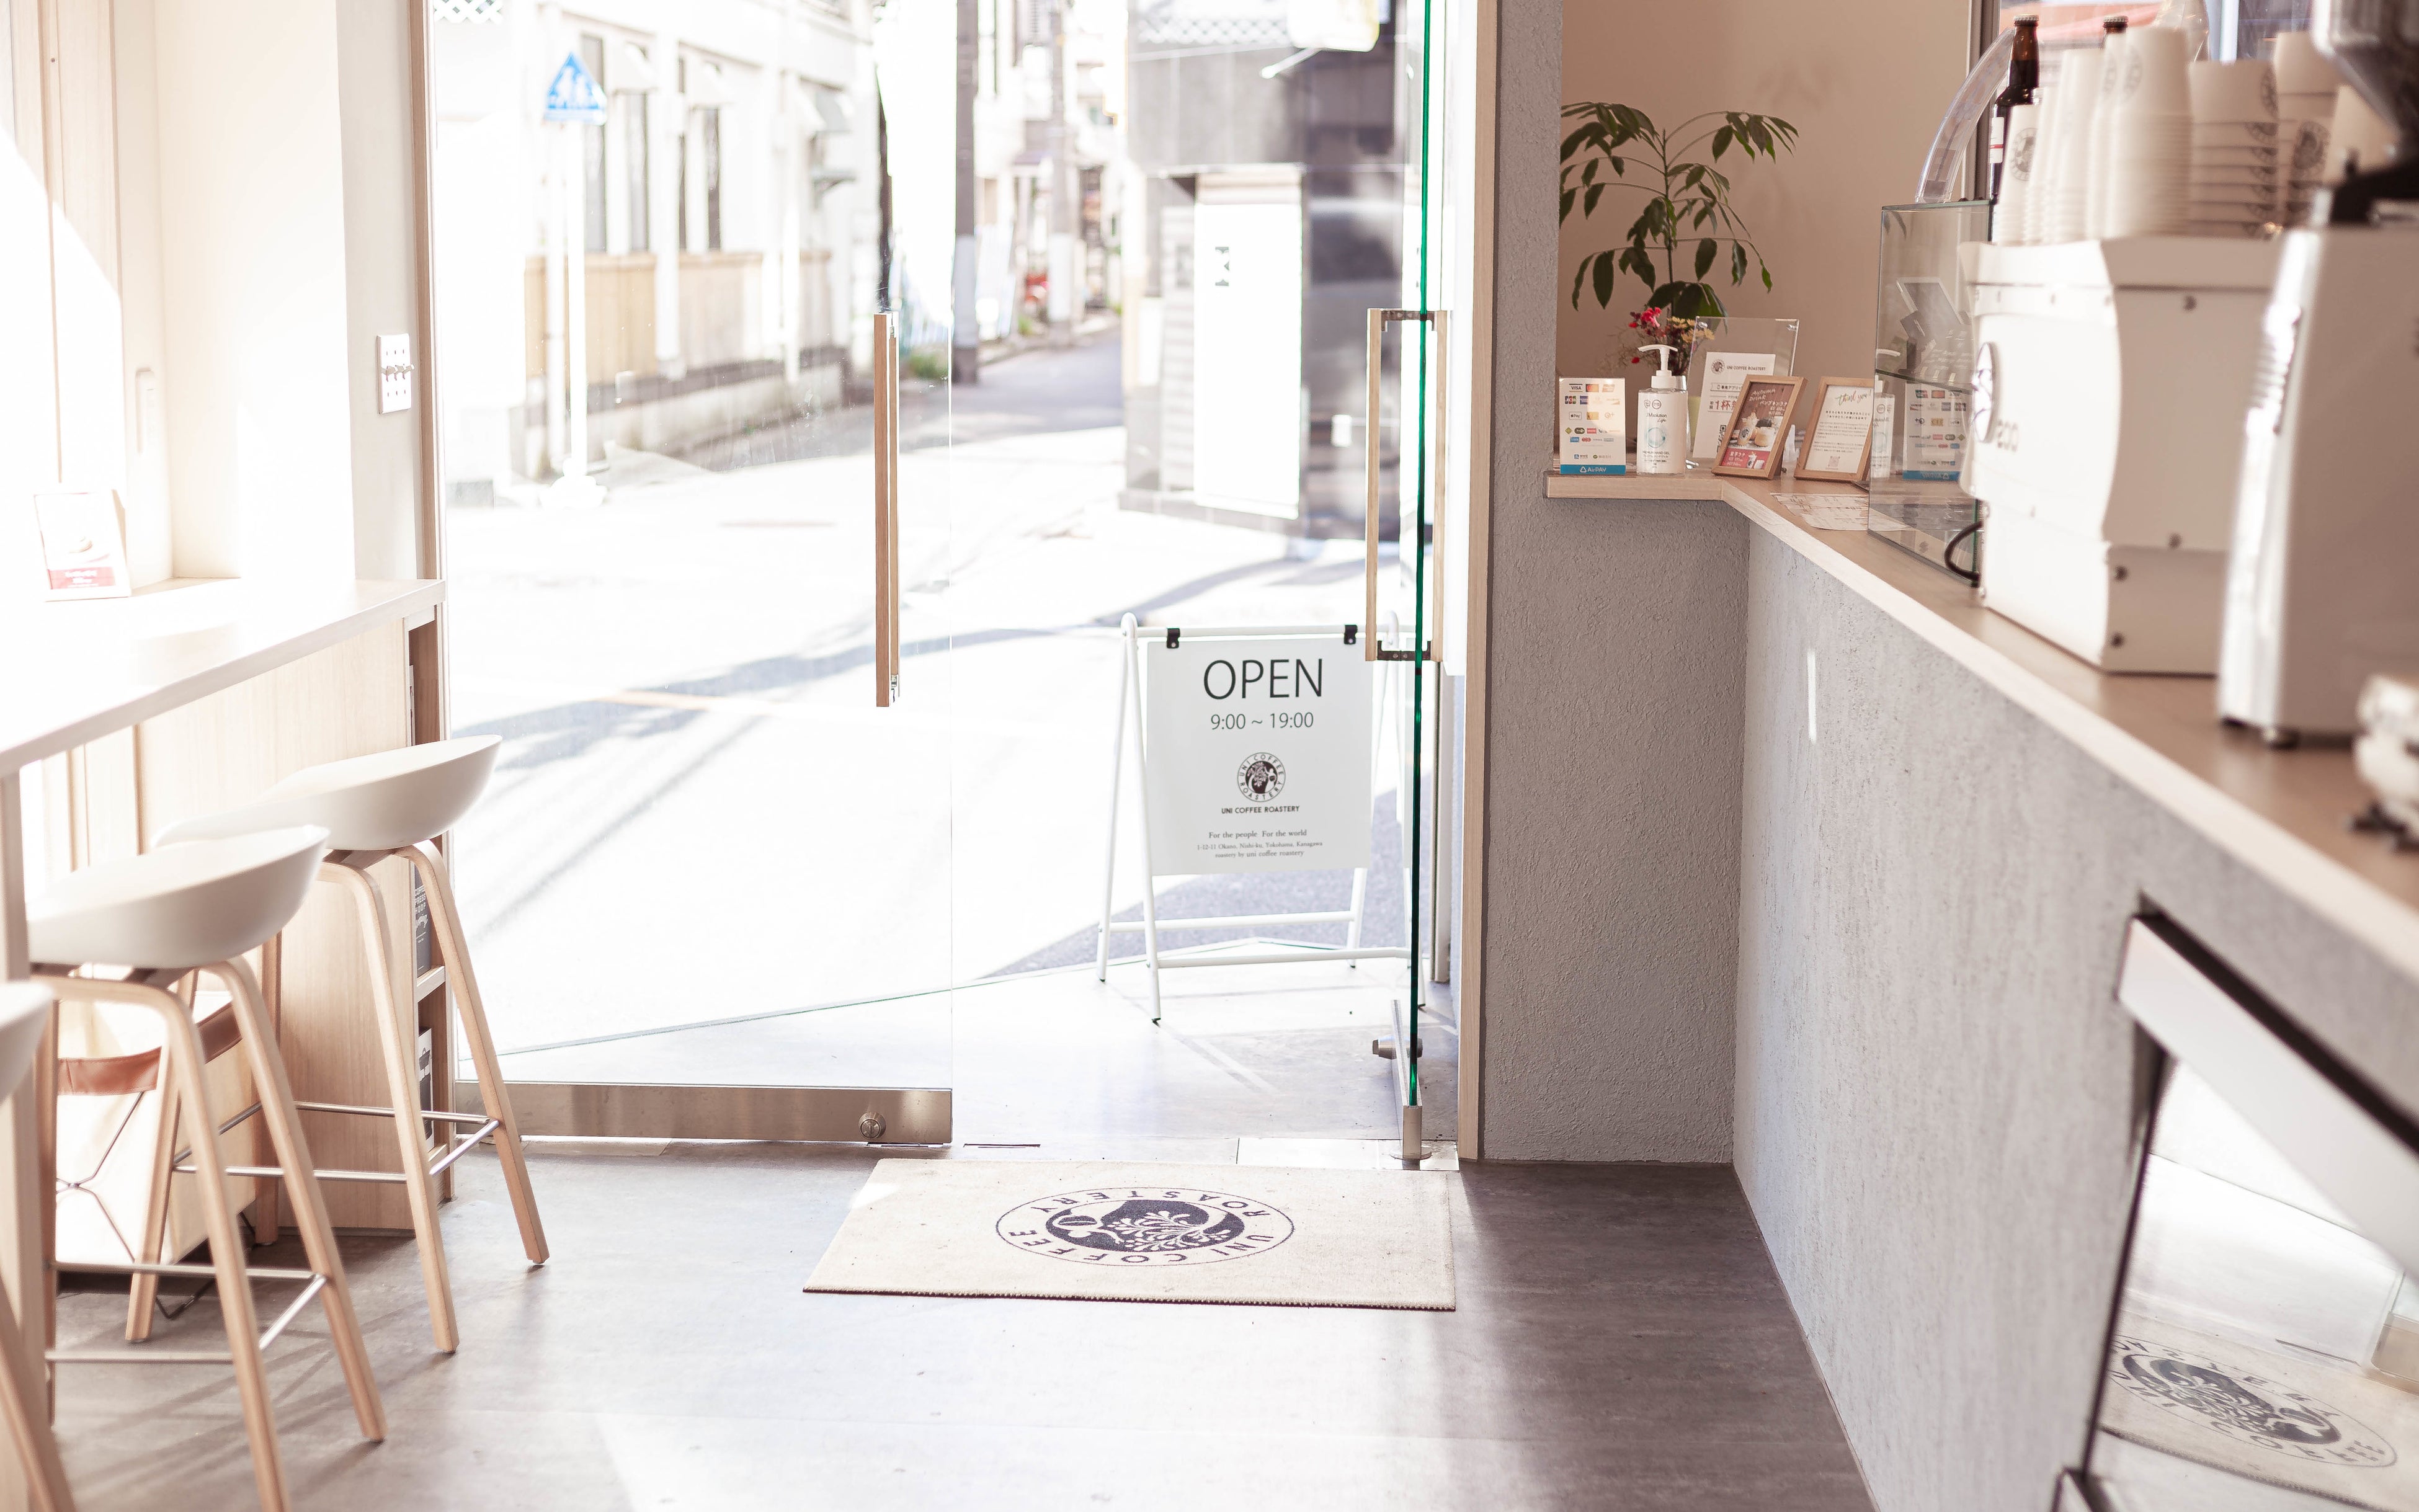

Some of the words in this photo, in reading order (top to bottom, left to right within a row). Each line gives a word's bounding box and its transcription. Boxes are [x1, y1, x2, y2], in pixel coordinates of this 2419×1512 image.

[1203, 658, 1322, 700] OPEN
[1210, 713, 1245, 730] 9:00
[1270, 712, 1314, 728] 19:00
[1254, 754, 1284, 775] COFFEE
[1240, 781, 1283, 801] ROASTERY
[1236, 830, 1258, 840] people
[1031, 1190, 1271, 1217] ROASTERY
[1009, 1229, 1188, 1263] COFFEE
[1211, 1234, 1275, 1255] UNI
